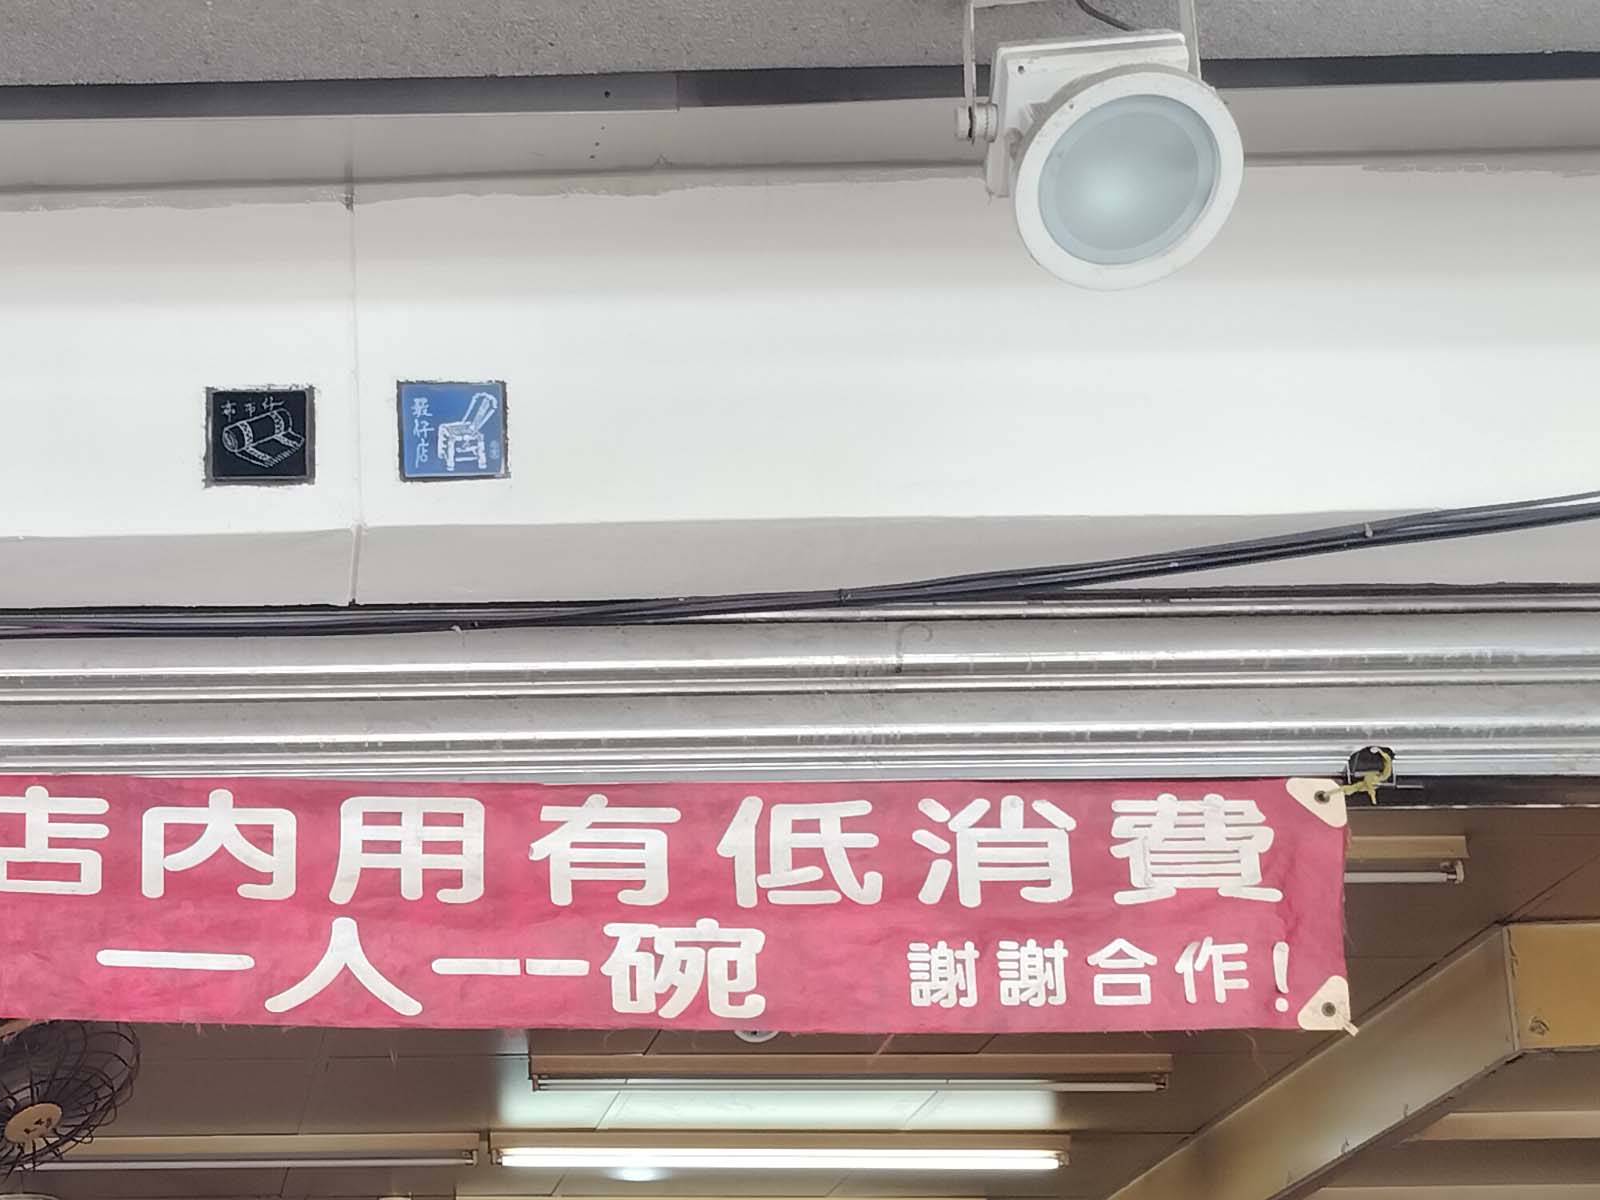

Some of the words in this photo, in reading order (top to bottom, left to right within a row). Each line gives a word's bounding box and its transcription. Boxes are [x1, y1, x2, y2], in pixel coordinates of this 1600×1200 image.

[96, 916, 766, 1019] 一人一碗
[907, 937, 1289, 1012] 謝謝合作!
